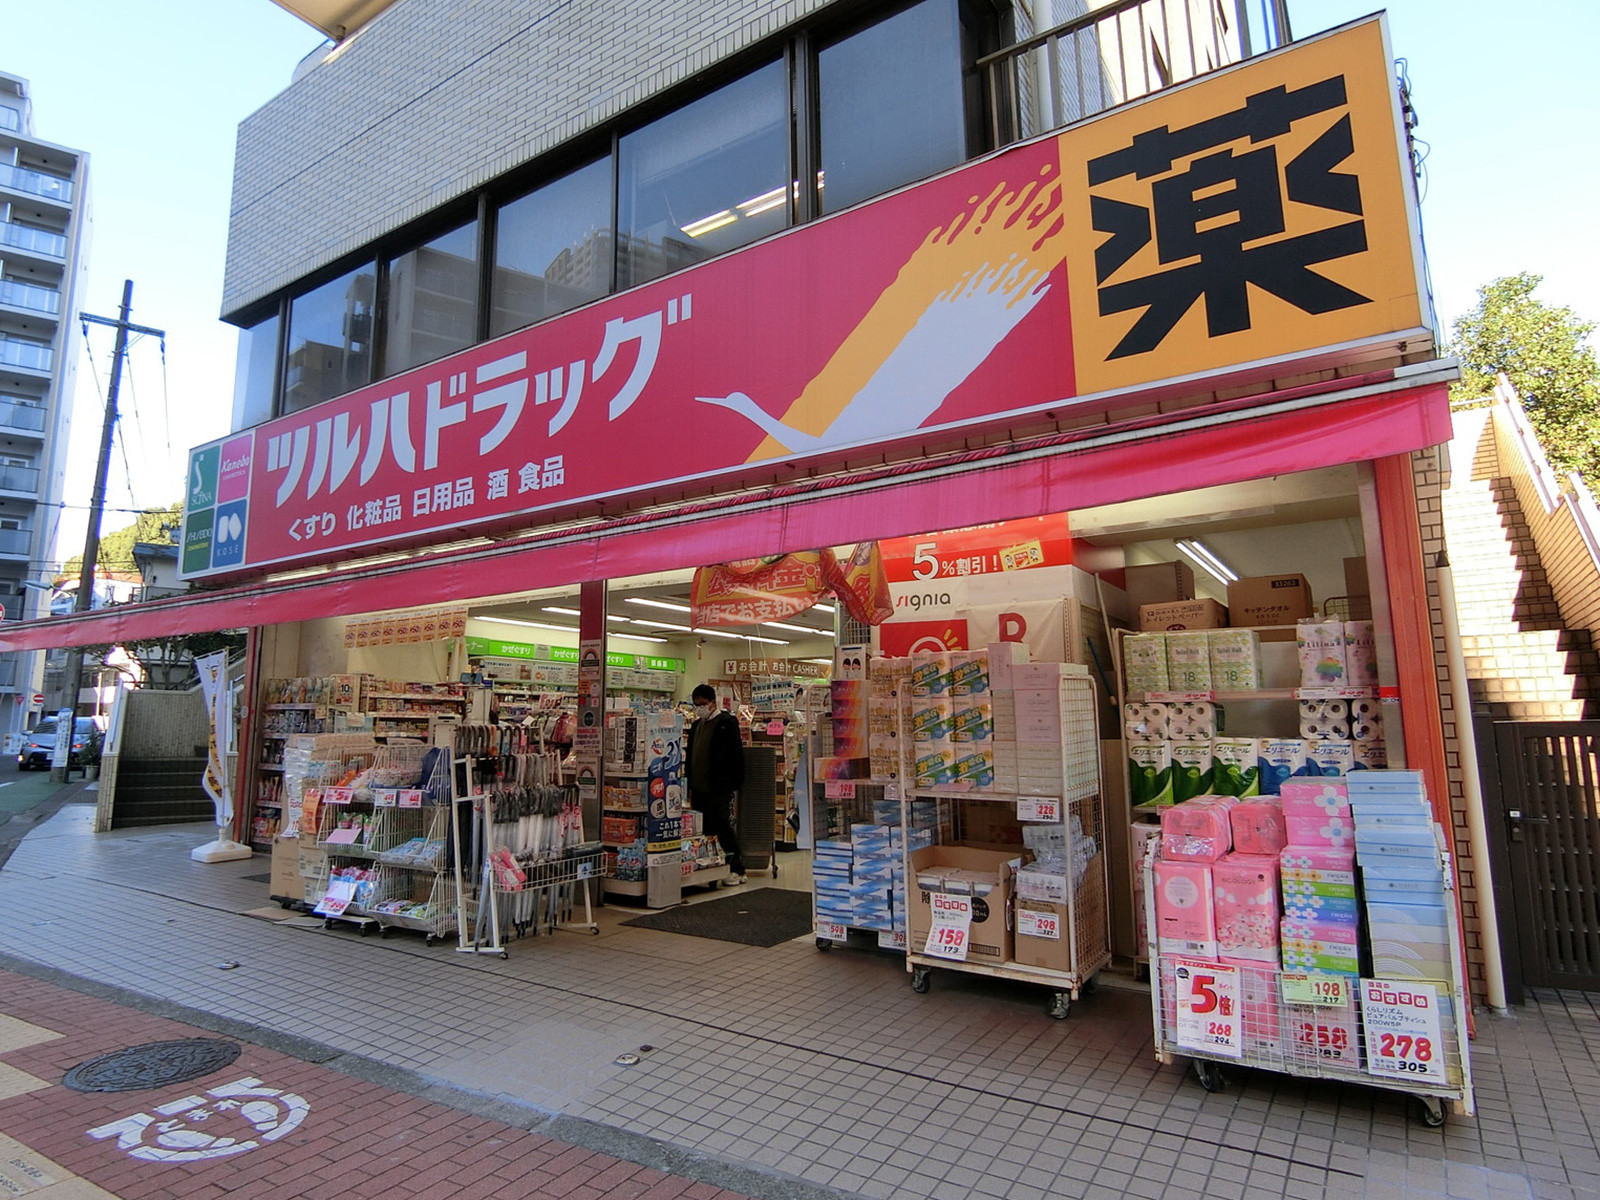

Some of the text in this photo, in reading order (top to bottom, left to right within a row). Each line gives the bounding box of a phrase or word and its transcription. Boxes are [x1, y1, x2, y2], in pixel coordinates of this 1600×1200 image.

[1087, 74, 1375, 361] 薬
[267, 293, 692, 508] ツルハドラッグ
[221, 455, 250, 473] Kanebo
[288, 455, 565, 541] くすり 化粧品 日用品 酒 食品
[896, 593, 950, 611] signia
[502, 645, 531, 655] かぜぐすり
[739, 660, 768, 672] お会計
[793, 663, 818, 675] CASHIER
[1184, 672, 1196, 682] 18
[1225, 671, 1238, 681] 18
[1216, 746, 1251, 754] エリエール
[840, 784, 853, 792] 198
[1038, 805, 1054, 815] 228
[831, 925, 844, 934] 598
[1037, 918, 1055, 930] 298
[938, 927, 965, 947] 158
[1328, 931, 1351, 939] nepia
[943, 945, 959, 954] 173
[1315, 982, 1340, 996] 198
[1366, 1006, 1403, 1015] くらしリズム
[1209, 1022, 1232, 1037] 268
[1299, 1022, 1347, 1049] 258
[1215, 1036, 1230, 1044] 294
[1380, 1033, 1432, 1061] 278
[1398, 1060, 1428, 1073] 305
[155, 1098, 243, 1133] とまれ
